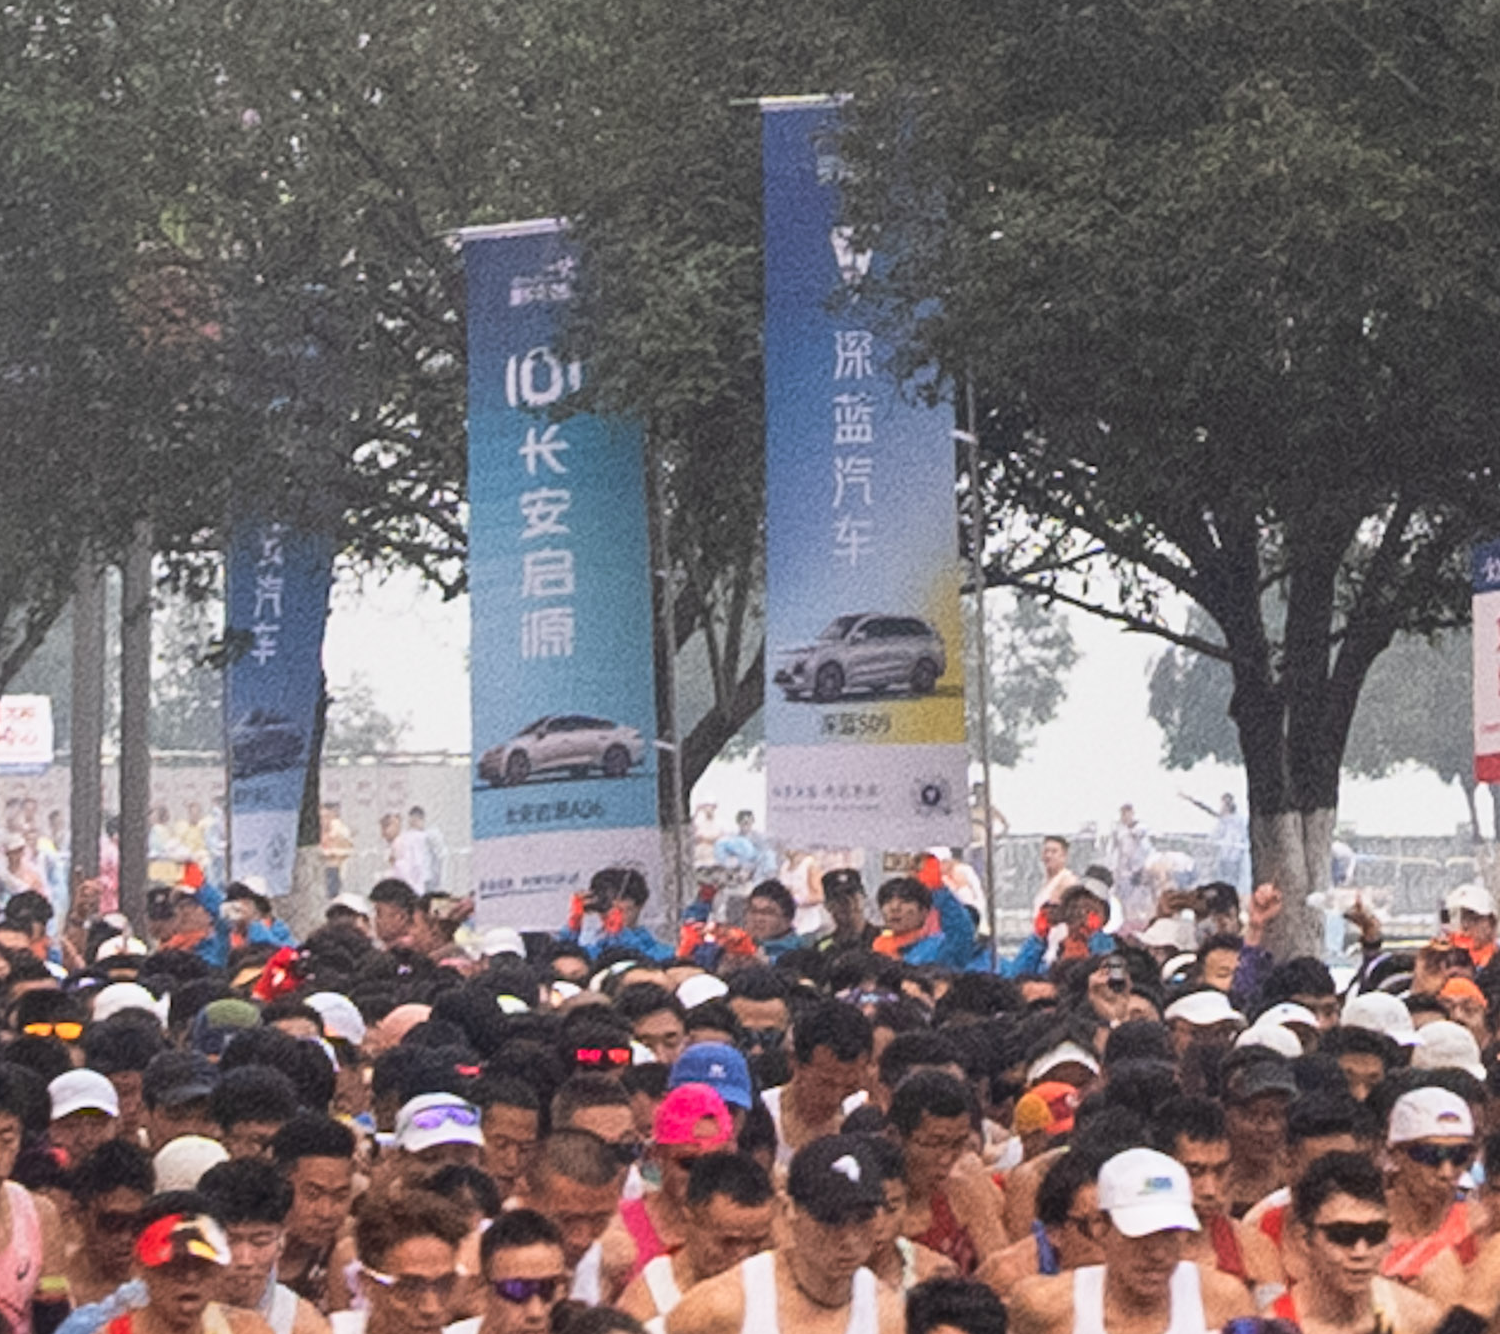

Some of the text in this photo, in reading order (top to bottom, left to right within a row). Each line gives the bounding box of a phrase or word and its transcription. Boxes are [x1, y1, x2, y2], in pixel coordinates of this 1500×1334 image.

[518, 423, 576, 660] 长安启源
[831, 329, 876, 567] 深蓝汽车
